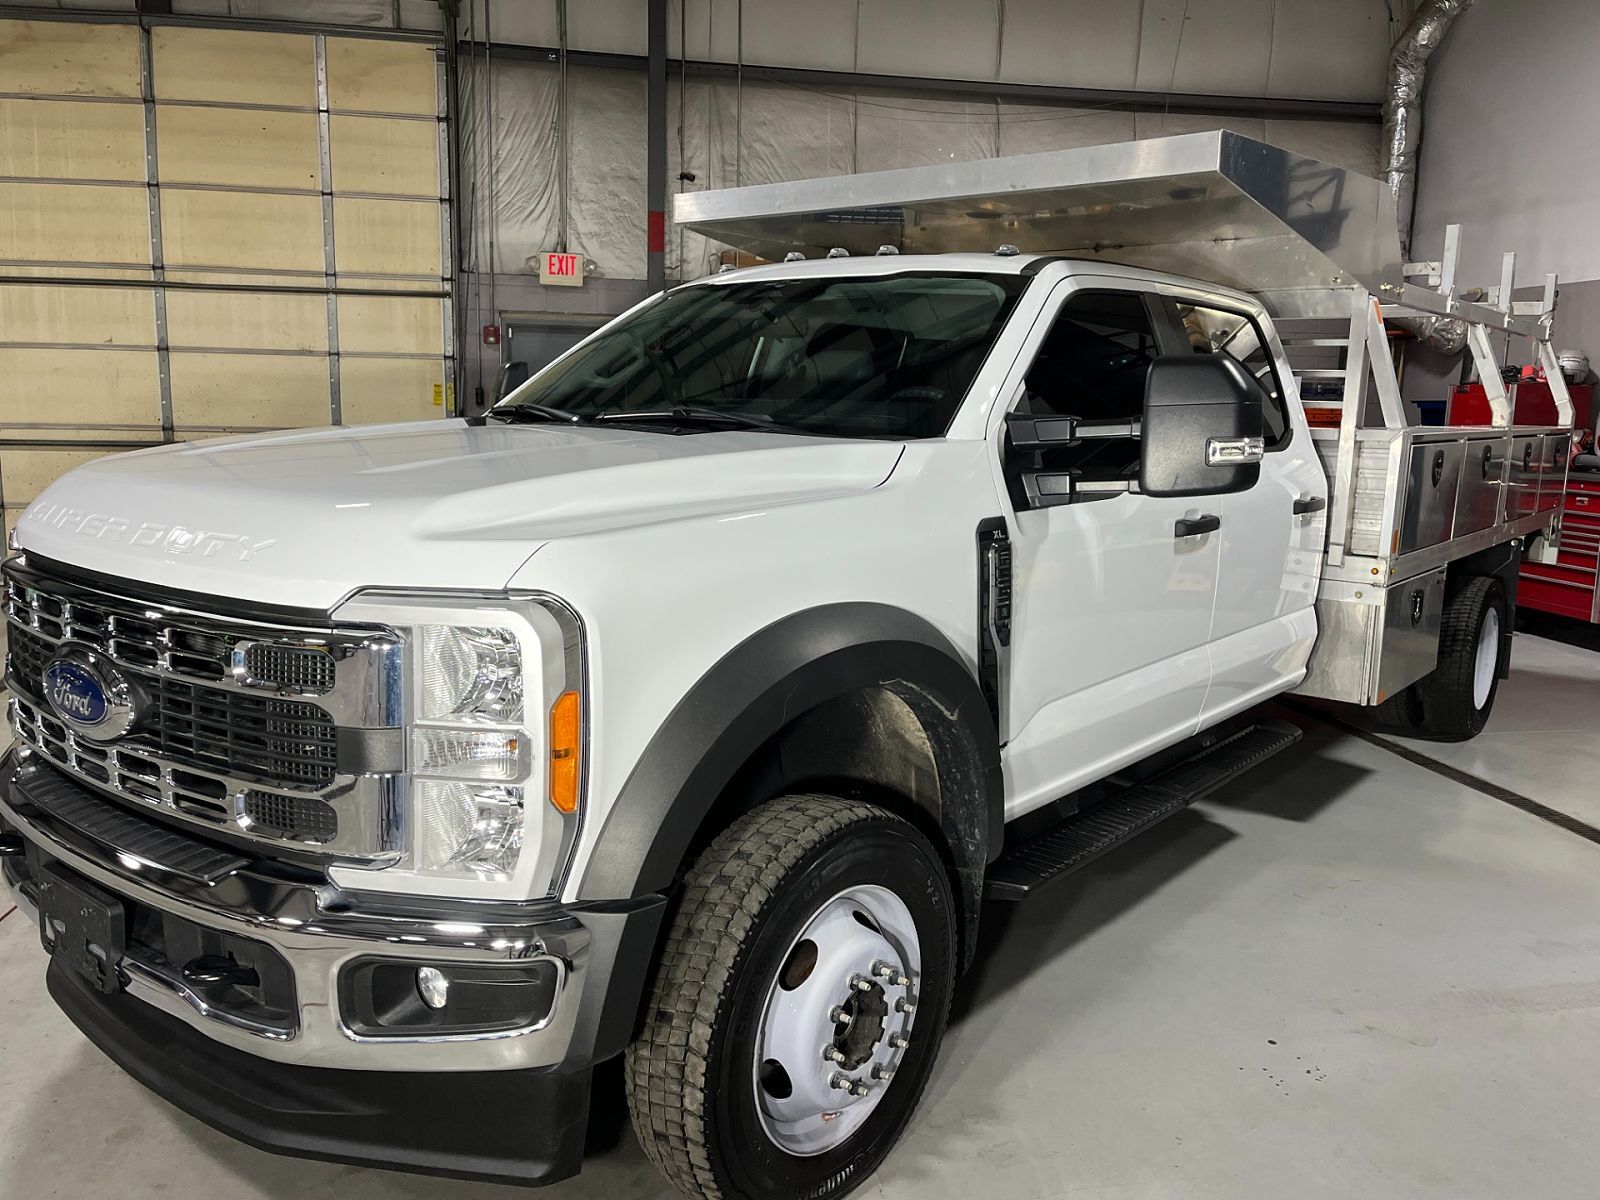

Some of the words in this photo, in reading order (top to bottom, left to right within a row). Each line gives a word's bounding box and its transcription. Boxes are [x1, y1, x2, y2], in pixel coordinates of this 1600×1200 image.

[548, 254, 577, 276] EXIT
[130, 522, 277, 561] DUTY
[992, 530, 1006, 539] XL
[54, 673, 92, 717] Ford
